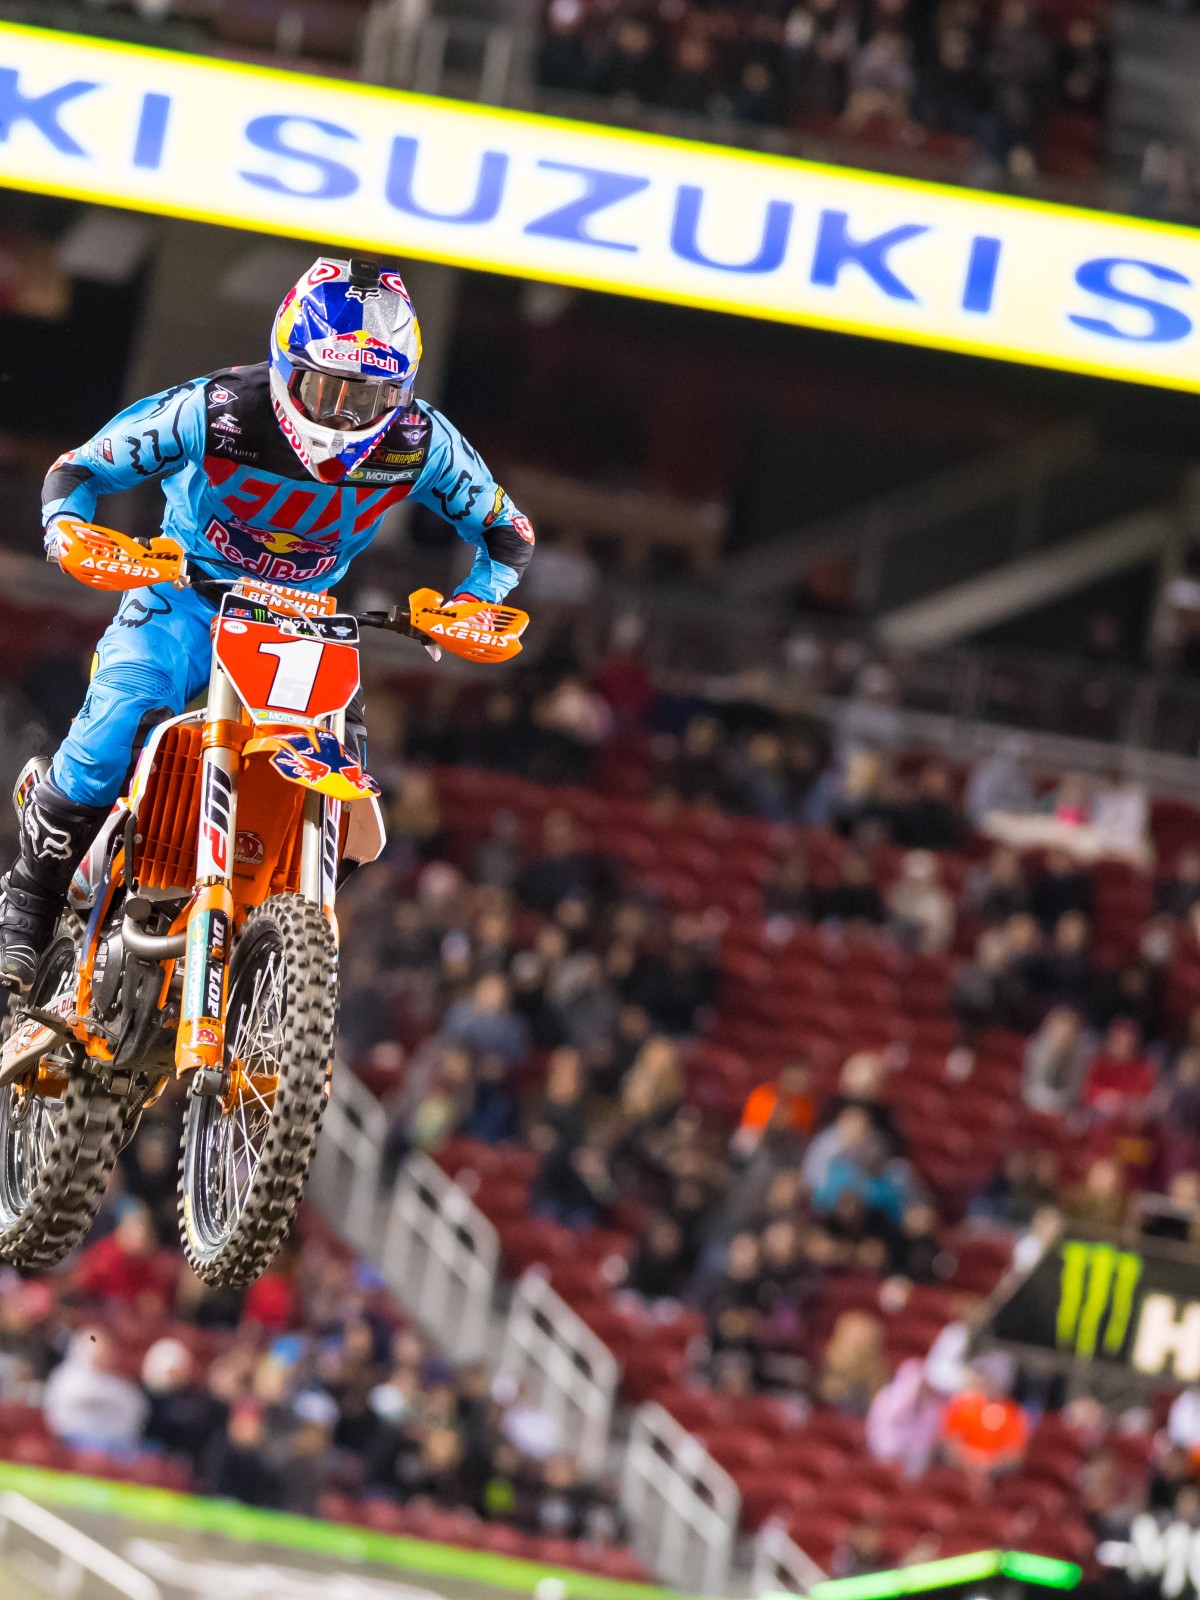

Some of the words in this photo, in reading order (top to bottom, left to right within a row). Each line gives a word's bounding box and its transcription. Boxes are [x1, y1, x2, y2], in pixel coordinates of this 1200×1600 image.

[239, 114, 1002, 313] SUZUKI
[321, 348, 360, 362] Red
[362, 349, 399, 374] Bull
[365, 470, 414, 482] MOTOREX
[204, 519, 271, 577] Red
[267, 554, 338, 581] Bull
[258, 638, 325, 713] 1
[268, 711, 313, 725] MOTOREX
